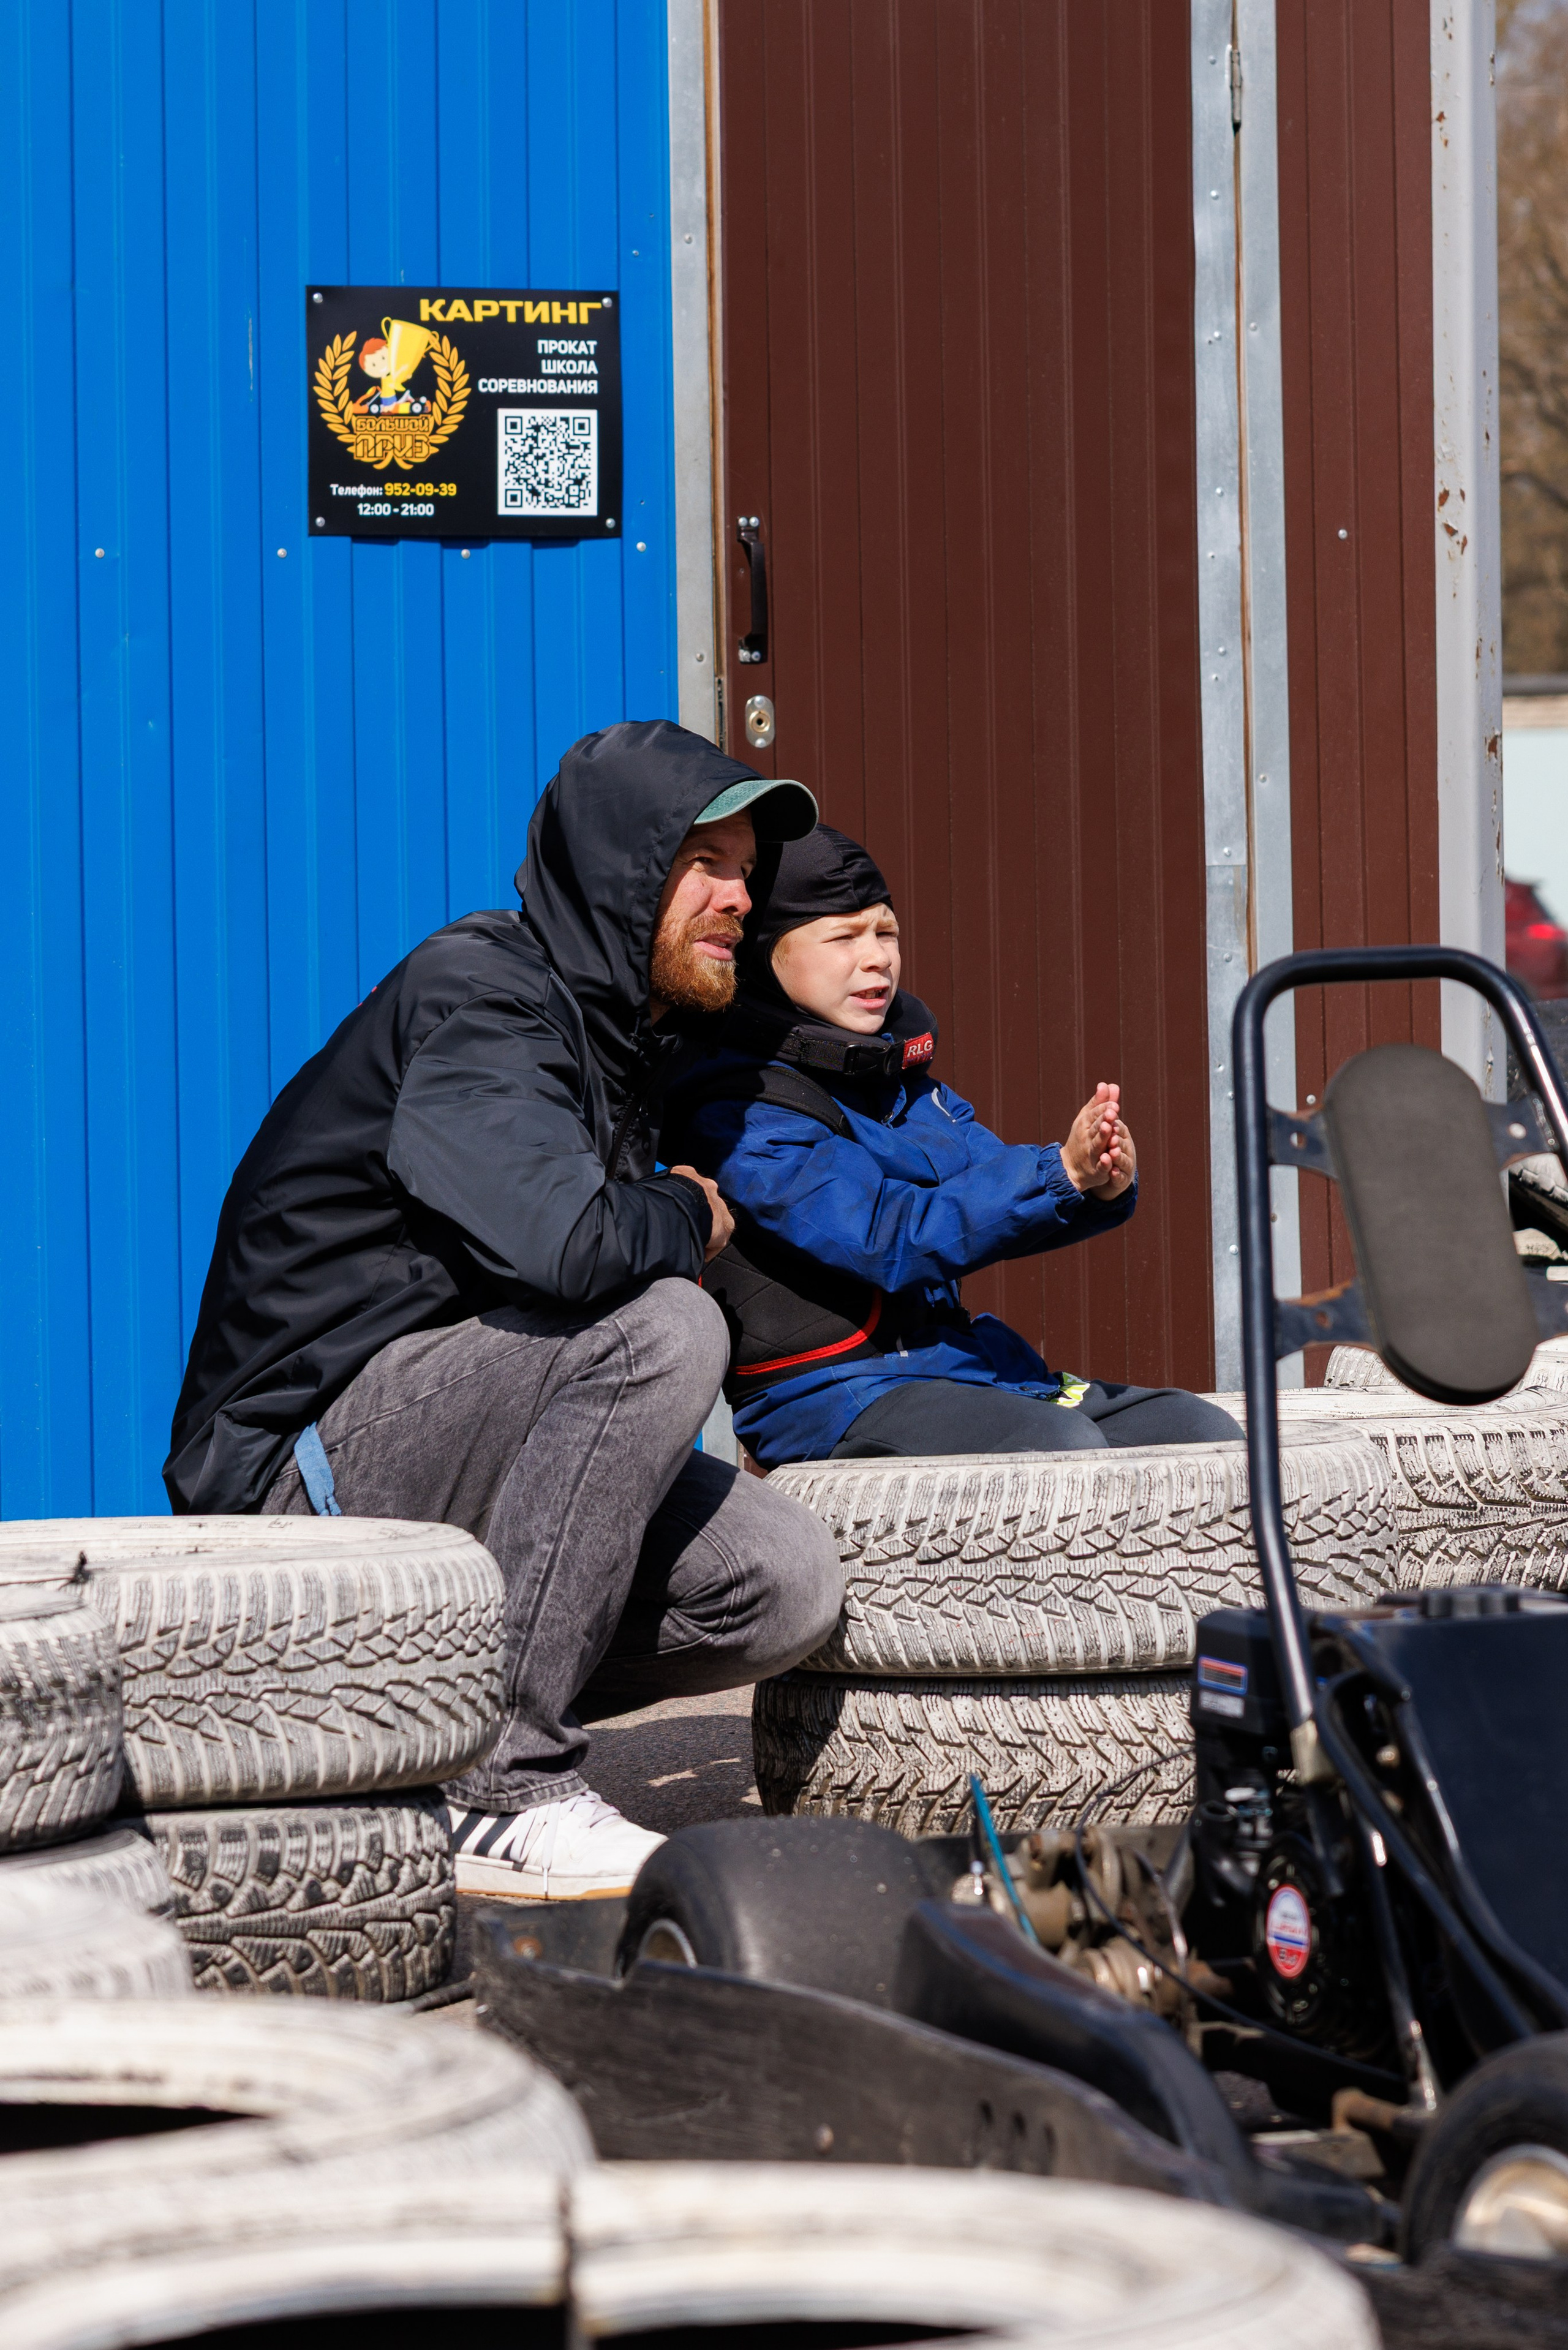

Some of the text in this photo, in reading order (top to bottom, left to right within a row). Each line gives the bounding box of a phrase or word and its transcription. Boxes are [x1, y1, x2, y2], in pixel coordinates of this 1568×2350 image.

[420, 298, 601, 324] КАРТИНГ
[537, 339, 598, 355] ПРОКАТ
[541, 359, 598, 374] ШКОЛА
[478, 378, 598, 394] СОРЕВНОВАНИЯ
[355, 415, 429, 432] БОЛЬШОЙ
[356, 434, 429, 458] ПРИЗ
[330, 483, 457, 498] Телефон: 952-09-39
[357, 503, 391, 516] 12:00
[401, 503, 434, 516] 21:00
[907, 1040, 932, 1058] RLG
